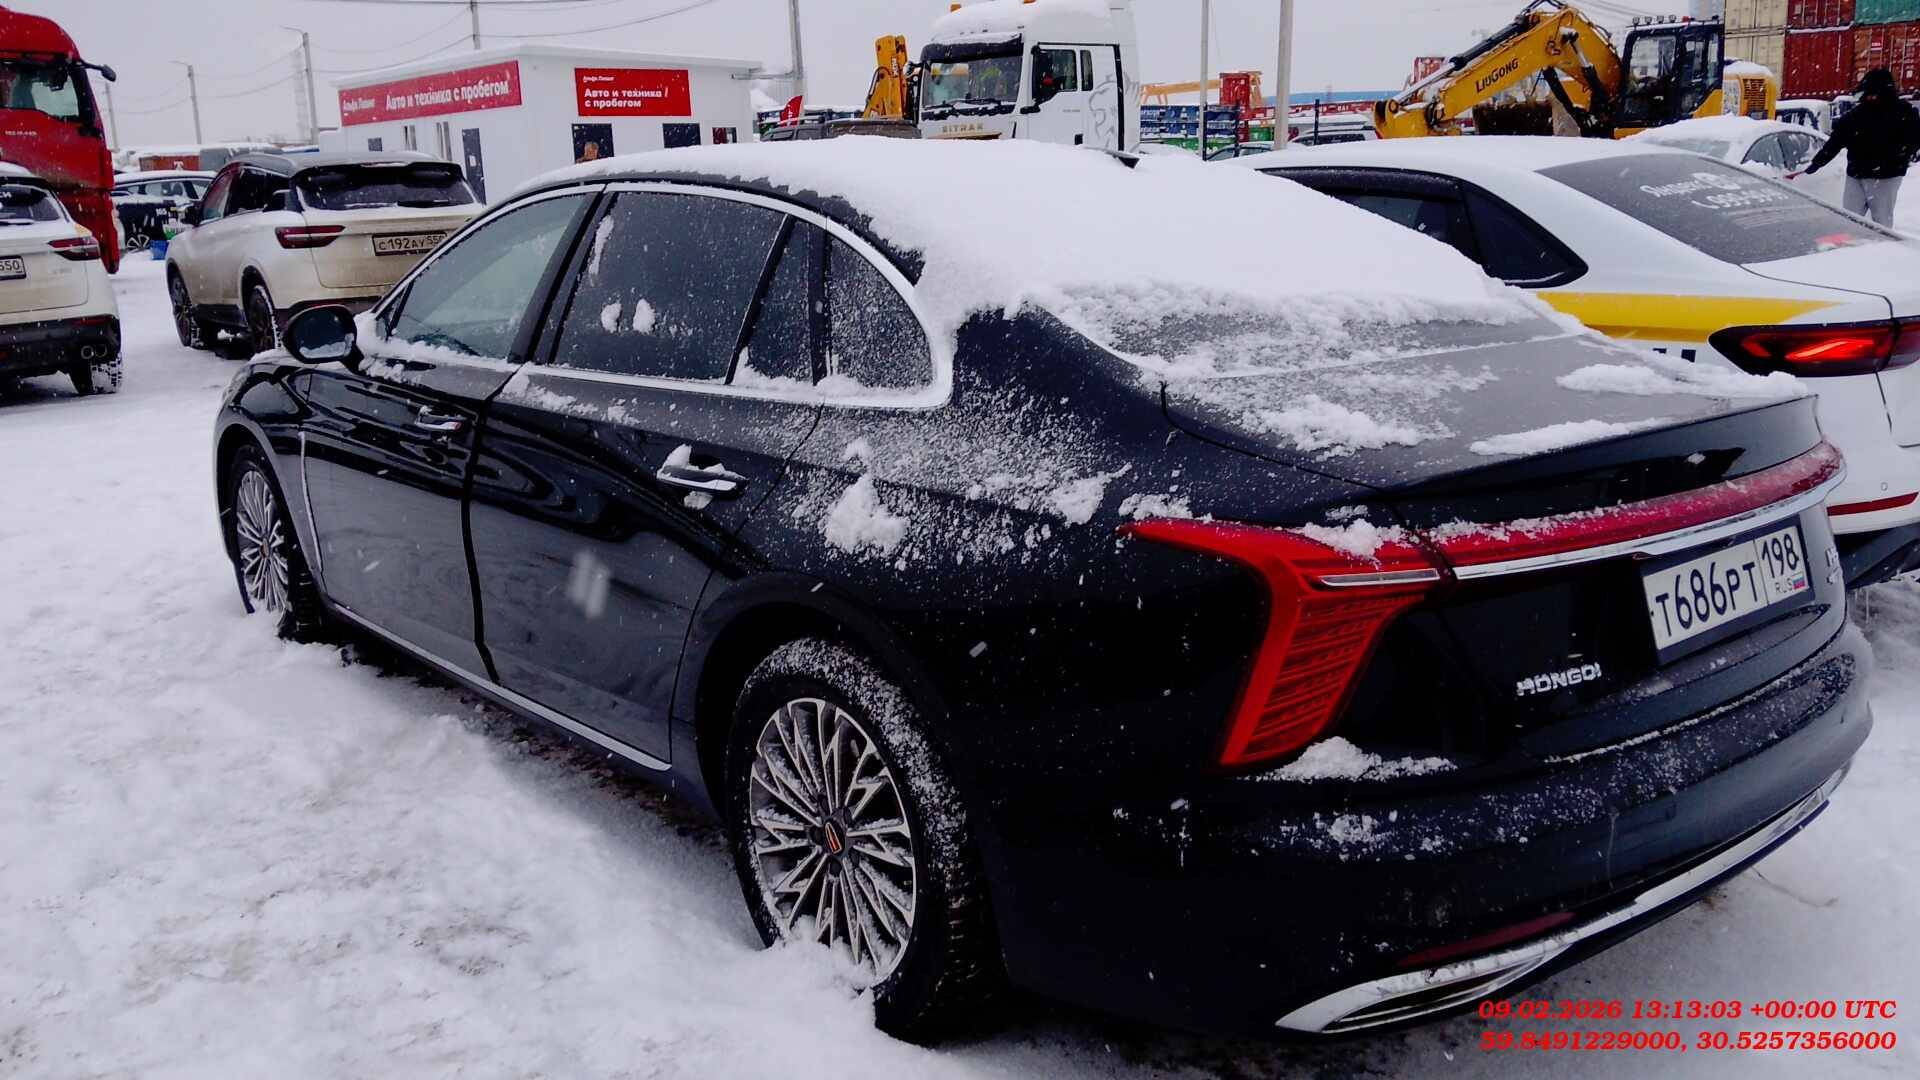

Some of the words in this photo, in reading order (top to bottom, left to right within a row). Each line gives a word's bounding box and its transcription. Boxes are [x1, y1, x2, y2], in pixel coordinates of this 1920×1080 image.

[386, 94, 406, 111] Авто
[407, 95, 413, 107] и
[415, 88, 452, 106] техника
[453, 88, 460, 101] с
[461, 80, 509, 102] пробегом
[584, 88, 610, 97] Авто
[622, 89, 662, 97] техника
[593, 98, 641, 109] пробегом
[1655, 562, 1758, 637] Т686РТ
[1761, 533, 1798, 579] 198
